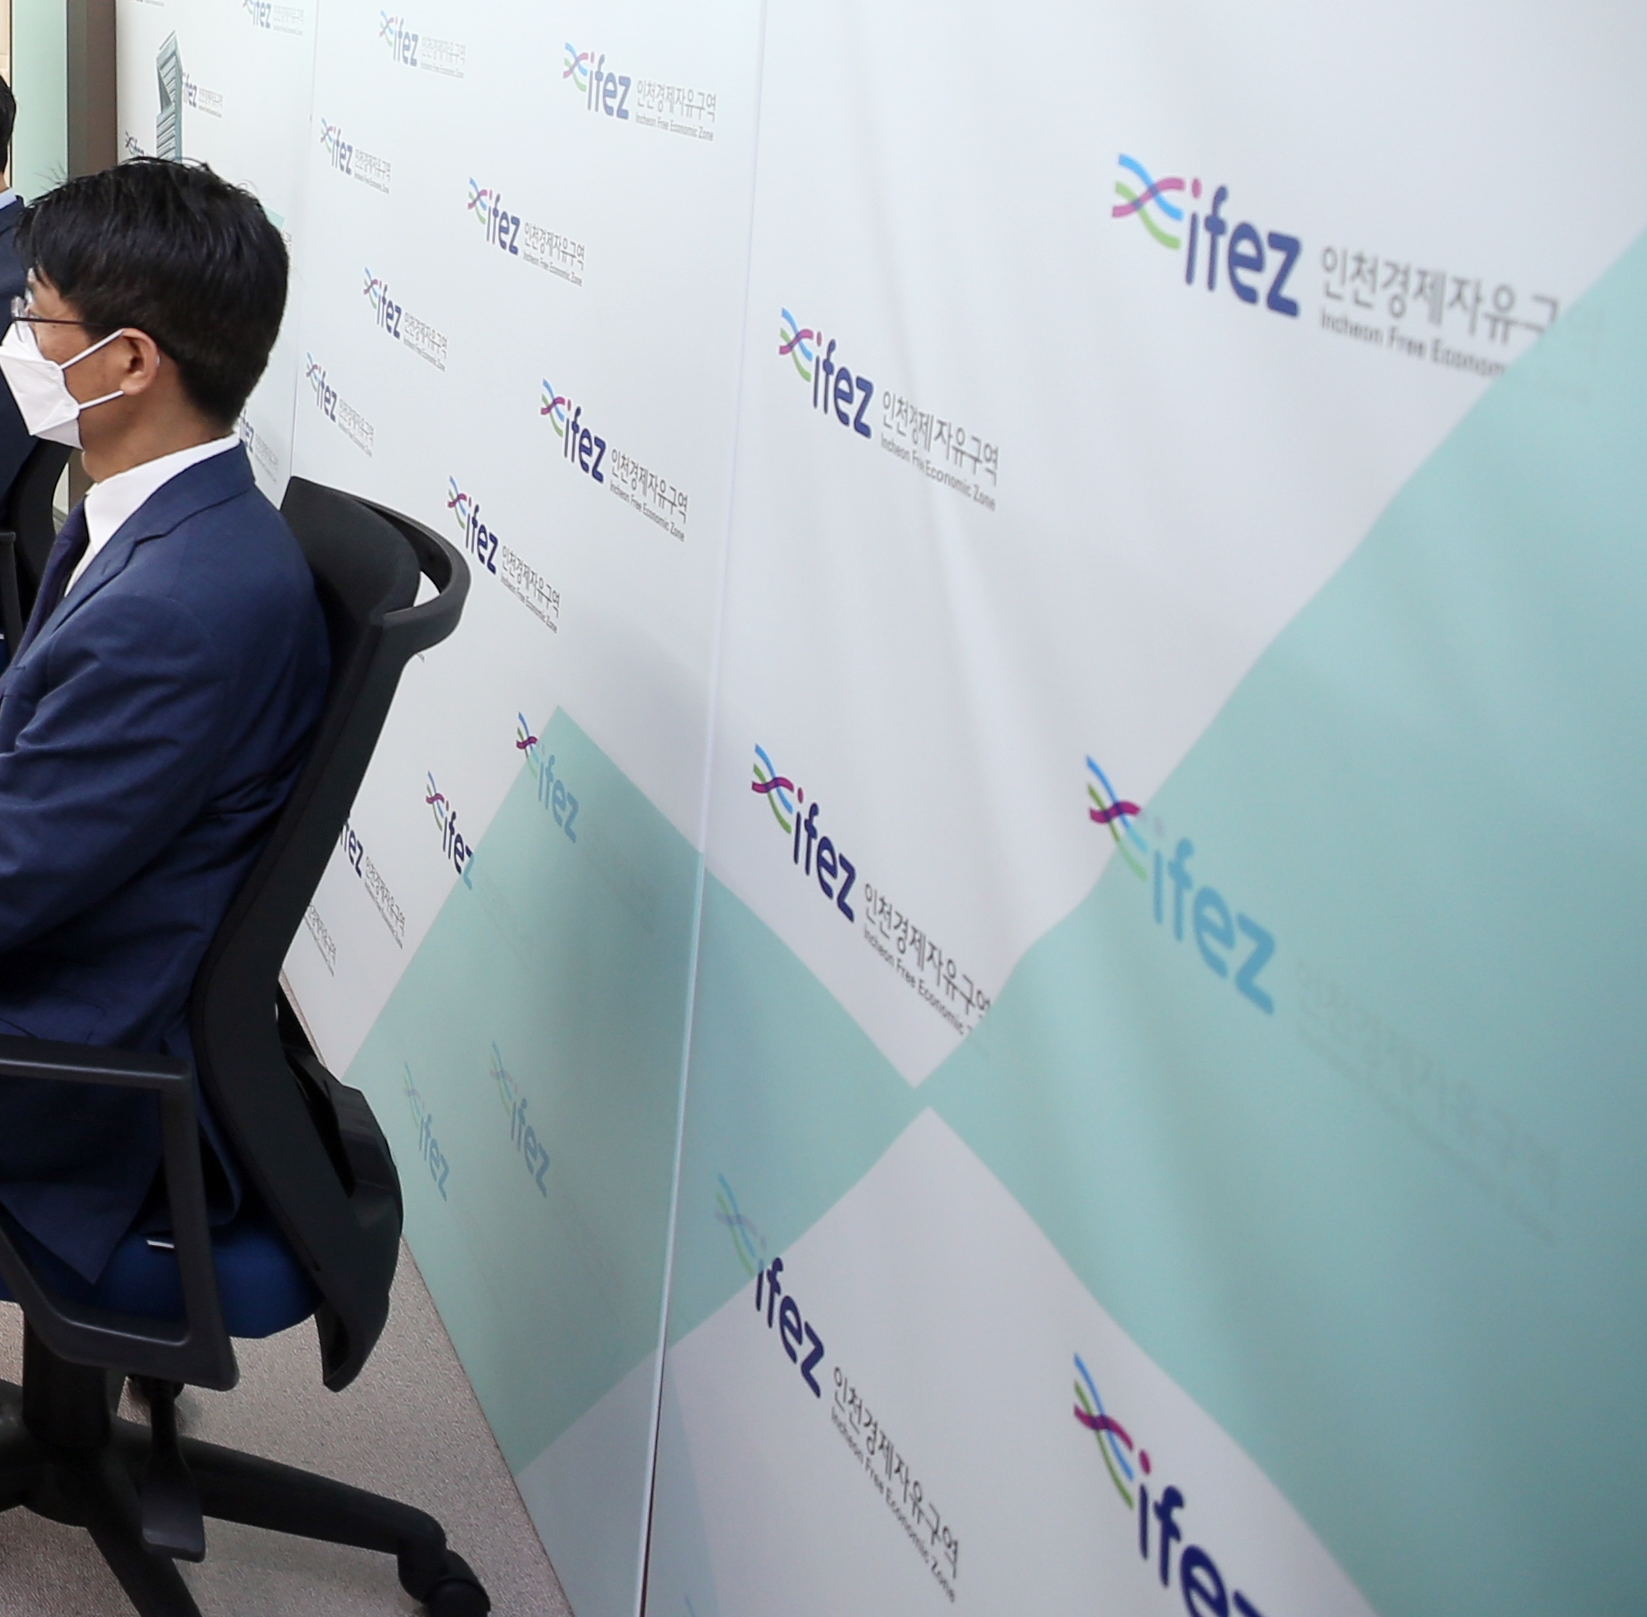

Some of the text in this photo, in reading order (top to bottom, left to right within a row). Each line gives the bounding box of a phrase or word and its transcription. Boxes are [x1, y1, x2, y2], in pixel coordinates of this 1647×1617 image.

[587, 51, 632, 120] ifez
[637, 79, 717, 123] 인천경제자유구역
[486, 189, 521, 256] ifez
[1185, 177, 1302, 319] ifez
[377, 280, 402, 340] ifez
[1321, 246, 1561, 345] 인천경제자유구
[1320, 307, 1507, 378] Incheon Free Econom
[813, 331, 875, 440] ifez
[564, 399, 607, 484] ifez
[882, 390, 999, 487] 인천경제자유구역
[611, 448, 689, 525] 인천경제자유구역
[465, 496, 498, 575] ifez
[793, 786, 856, 923] ifez
[1152, 815, 1276, 1016] ifez
[755, 1238, 825, 1399] ifez
